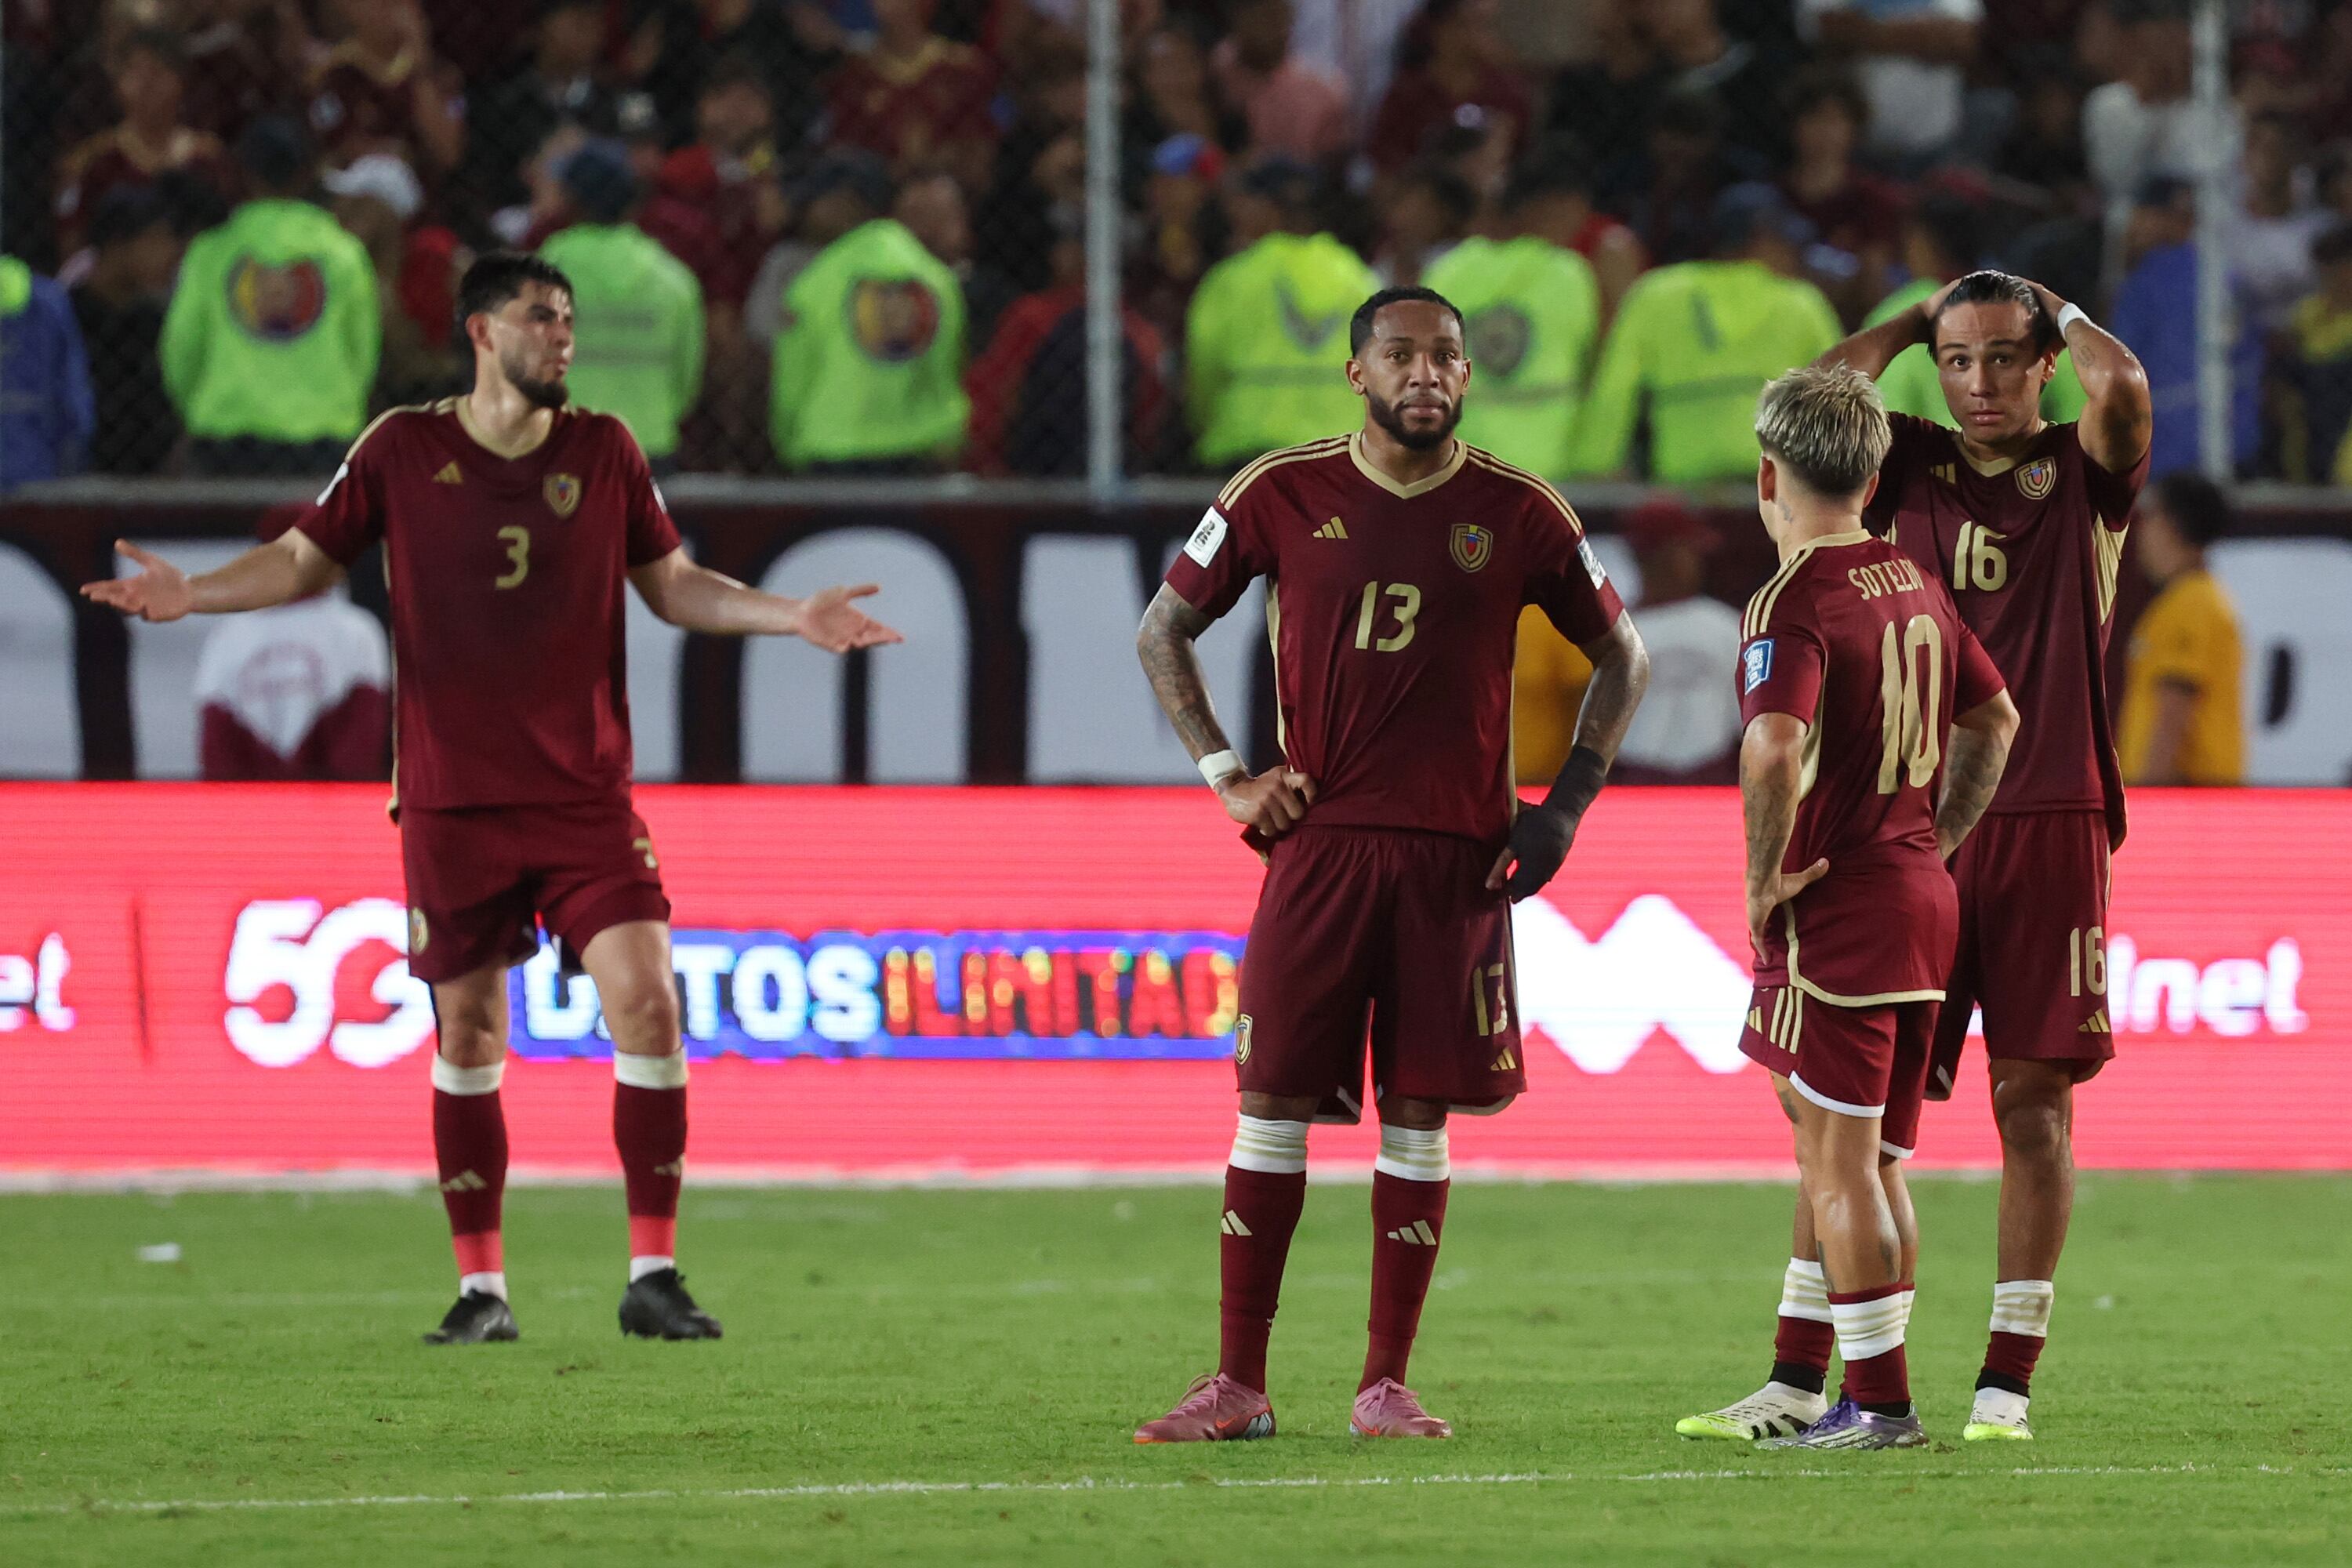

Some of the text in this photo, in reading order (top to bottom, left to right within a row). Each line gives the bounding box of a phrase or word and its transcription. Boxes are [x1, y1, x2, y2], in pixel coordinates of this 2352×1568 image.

[495, 526, 529, 589] 3
[1953, 521, 2008, 591] 16
[1354, 580, 1421, 652] 13
[1877, 614, 1943, 795] 10
[2070, 926, 2107, 996] 16
